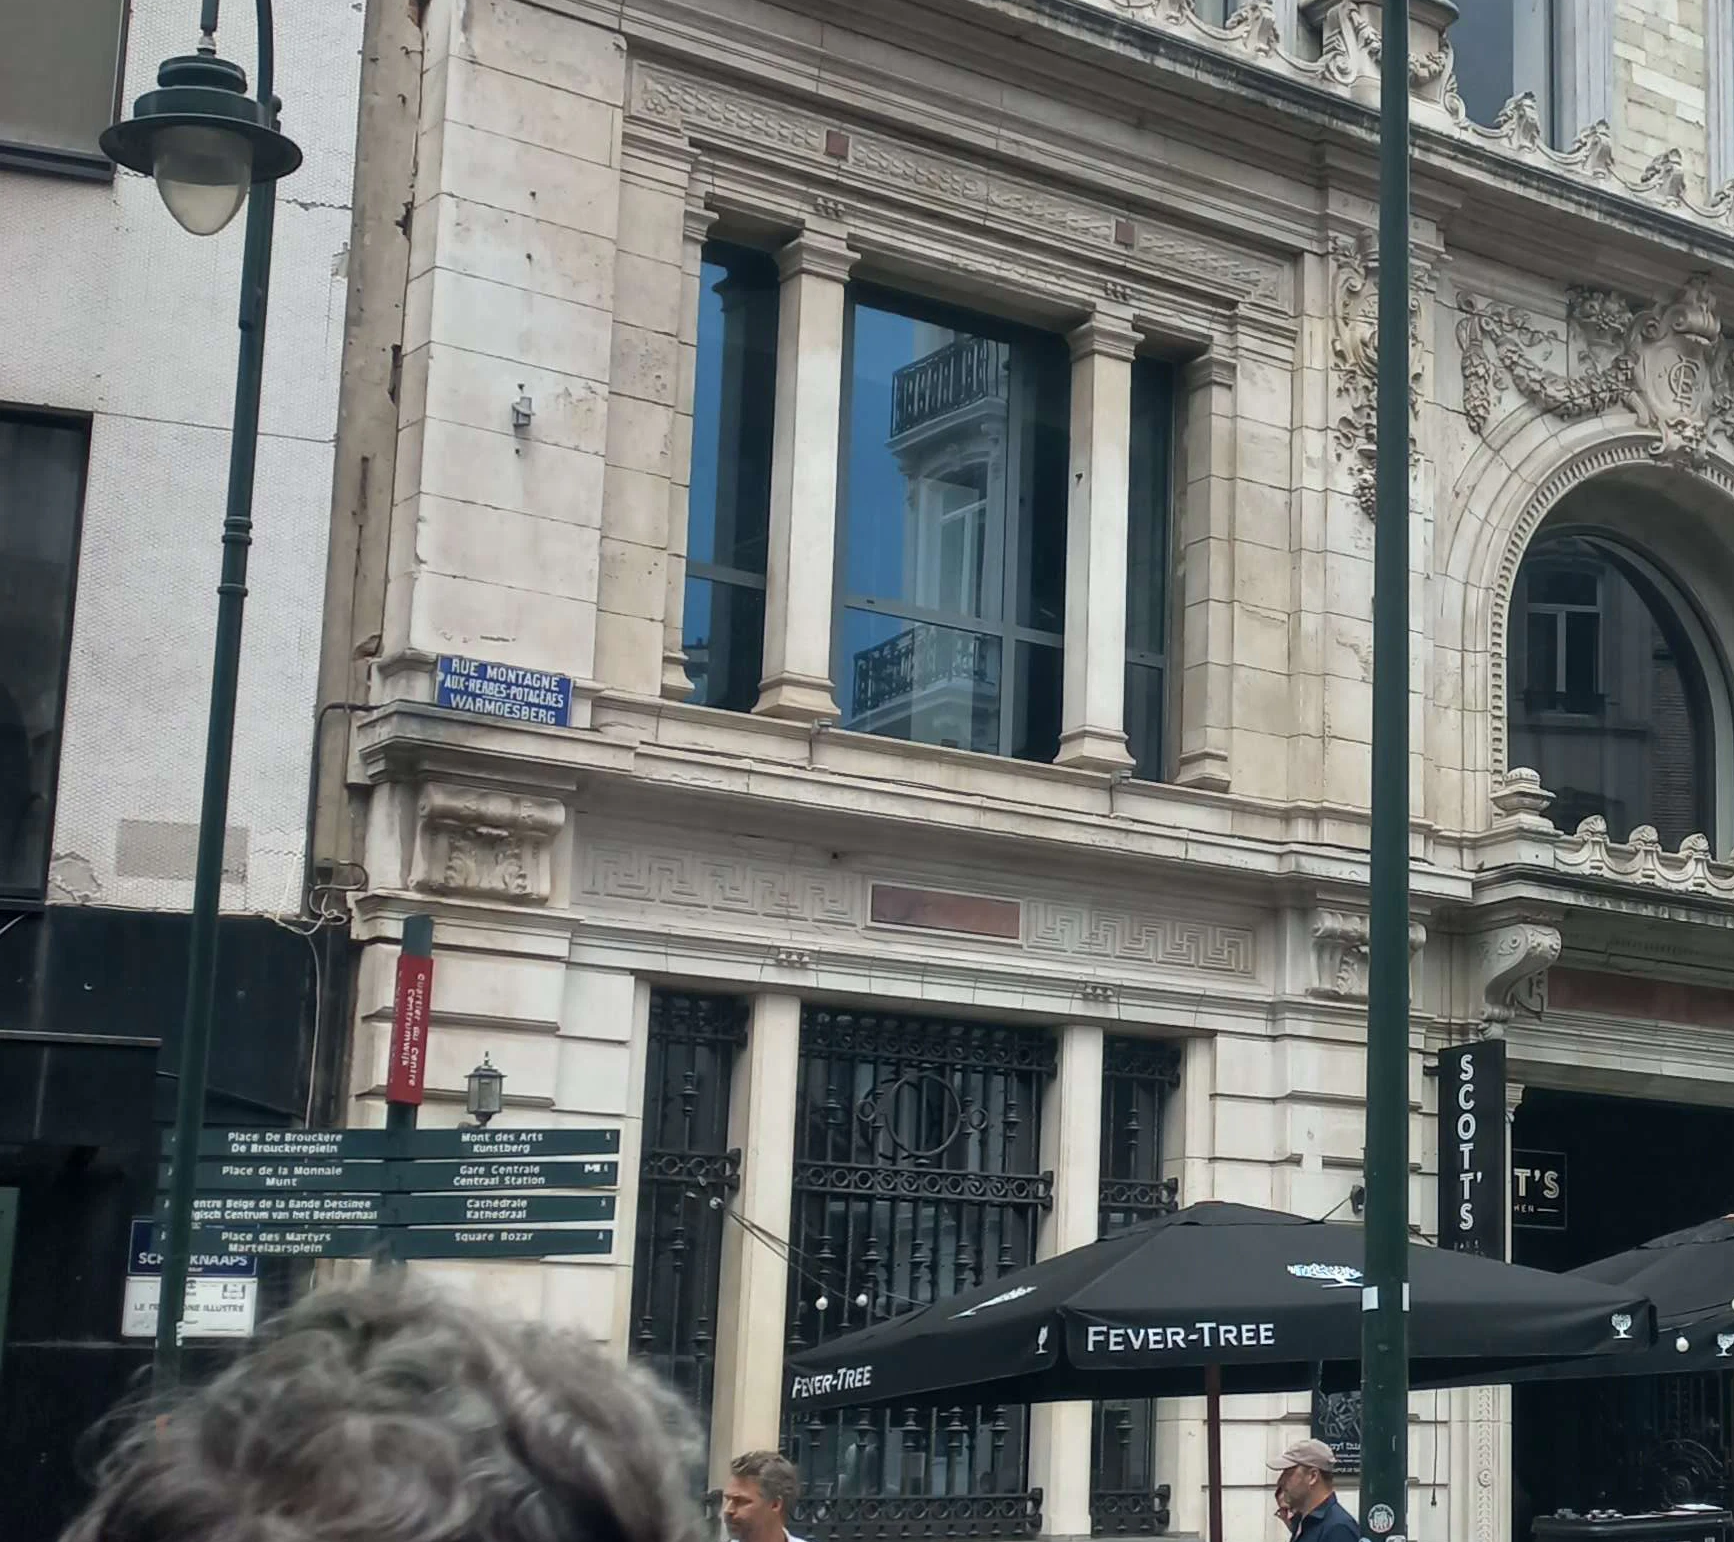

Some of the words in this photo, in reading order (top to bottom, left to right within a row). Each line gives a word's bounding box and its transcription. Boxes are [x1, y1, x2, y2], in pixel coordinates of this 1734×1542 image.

[451, 659, 480, 677] RUE
[486, 665, 560, 691] MONTAGNE
[450, 694, 556, 725] WARMOESBERG
[228, 1132, 259, 1142] Place
[265, 1132, 280, 1142] De
[461, 1132, 490, 1142] Mont
[495, 1132, 515, 1142] des
[519, 1132, 544, 1142] Arts
[1457, 1053, 1483, 1231] SCOTT'S
[231, 1143, 247, 1153] De
[473, 1143, 531, 1154] Kunstberg
[222, 1165, 253, 1176] Place
[258, 1165, 273, 1176] de
[278, 1165, 289, 1176] la
[293, 1165, 343, 1176] Monnaie
[459, 1165, 485, 1175] Gare
[491, 1165, 541, 1175] Centrale
[265, 1177, 298, 1187] Munt
[453, 1176, 500, 1187] Centraal
[504, 1176, 546, 1186] Station
[192, 1199, 222, 1209] entre
[226, 1199, 255, 1210] Belge
[259, 1199, 272, 1209] de
[275, 1199, 285, 1209] la
[191, 1210, 221, 1221] lgisch
[224, 1210, 269, 1220] Centrum
[272, 1210, 290, 1220] van
[292, 1210, 311, 1220] het
[466, 1209, 527, 1219] Kathedraal
[221, 1231, 253, 1241] Place
[258, 1231, 280, 1241] des
[285, 1231, 332, 1243] Martyrs
[454, 1231, 495, 1243] Square
[500, 1232, 534, 1241] Bozar
[228, 1242, 323, 1255] Martelaarsplein
[1087, 1322, 1275, 1352] FEVER-TREE
[791, 1365, 872, 1399] FEVER-TREE
